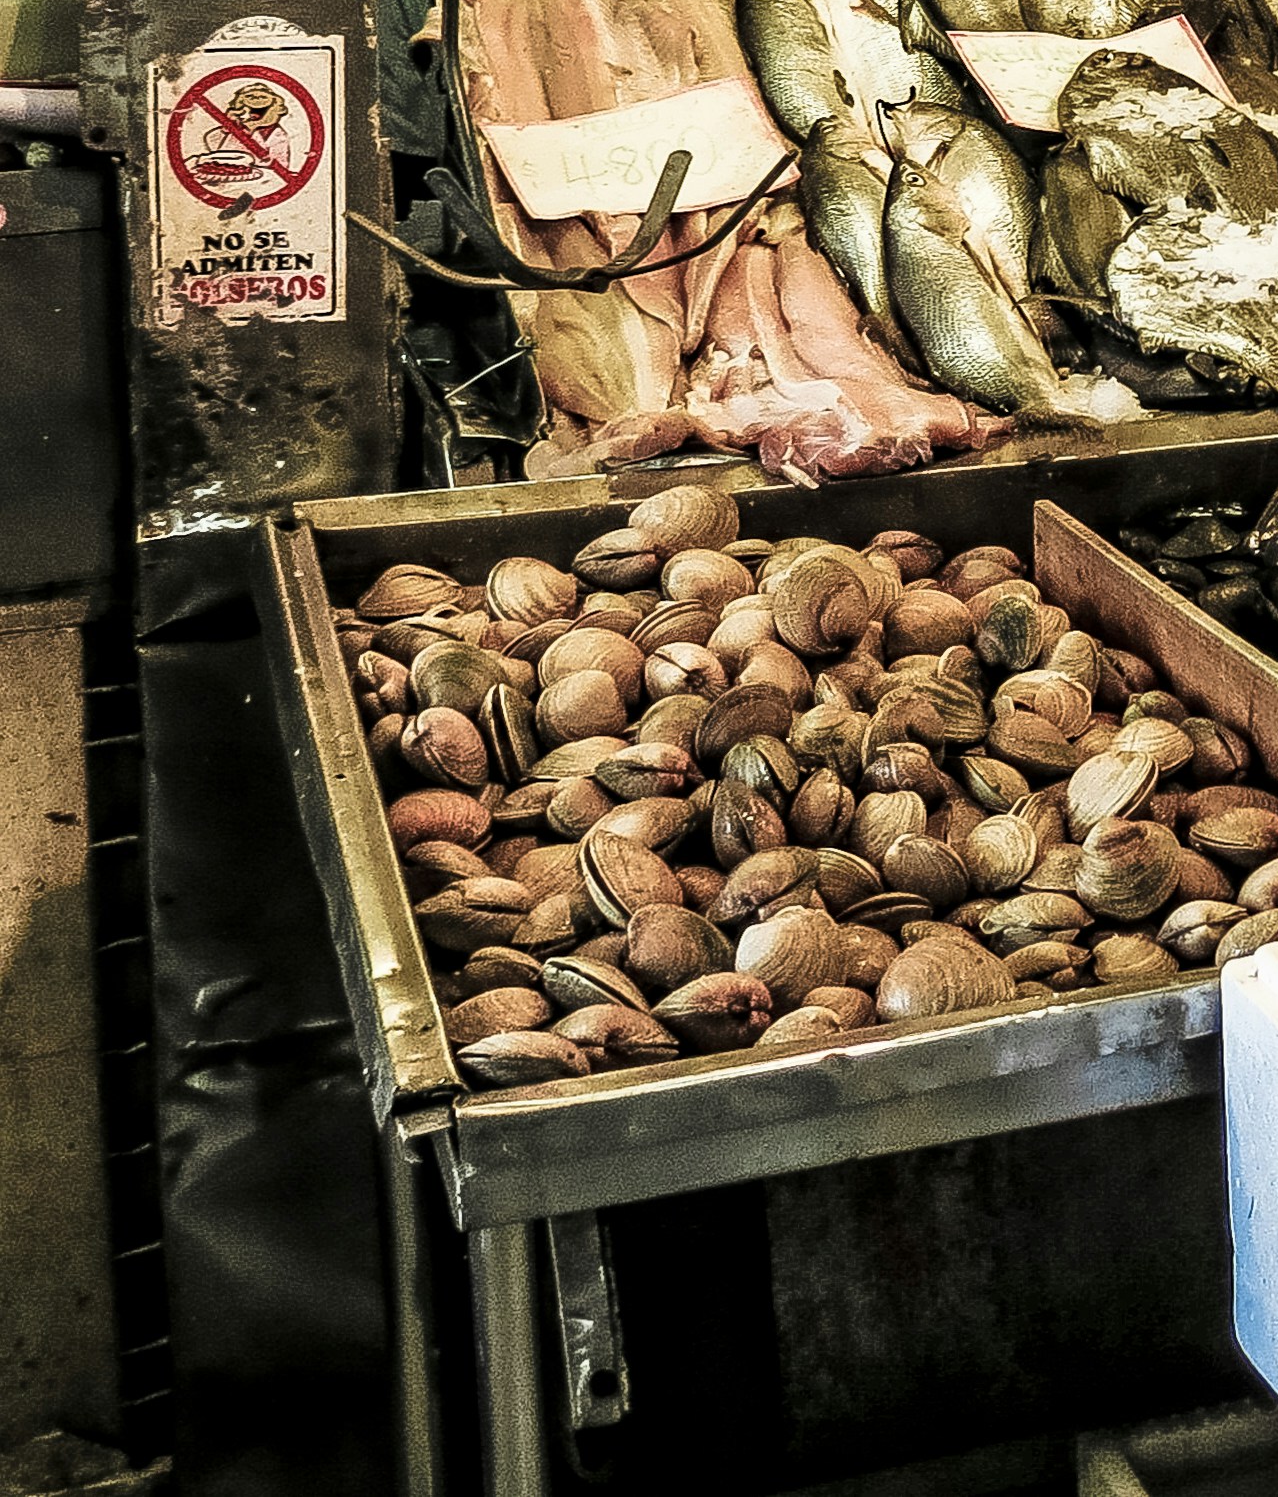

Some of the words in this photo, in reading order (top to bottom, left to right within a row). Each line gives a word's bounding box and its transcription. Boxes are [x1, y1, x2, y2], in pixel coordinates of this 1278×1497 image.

[202, 233, 245, 252] NO
[254, 231, 290, 249] SE
[182, 253, 315, 277] ADMITEN
